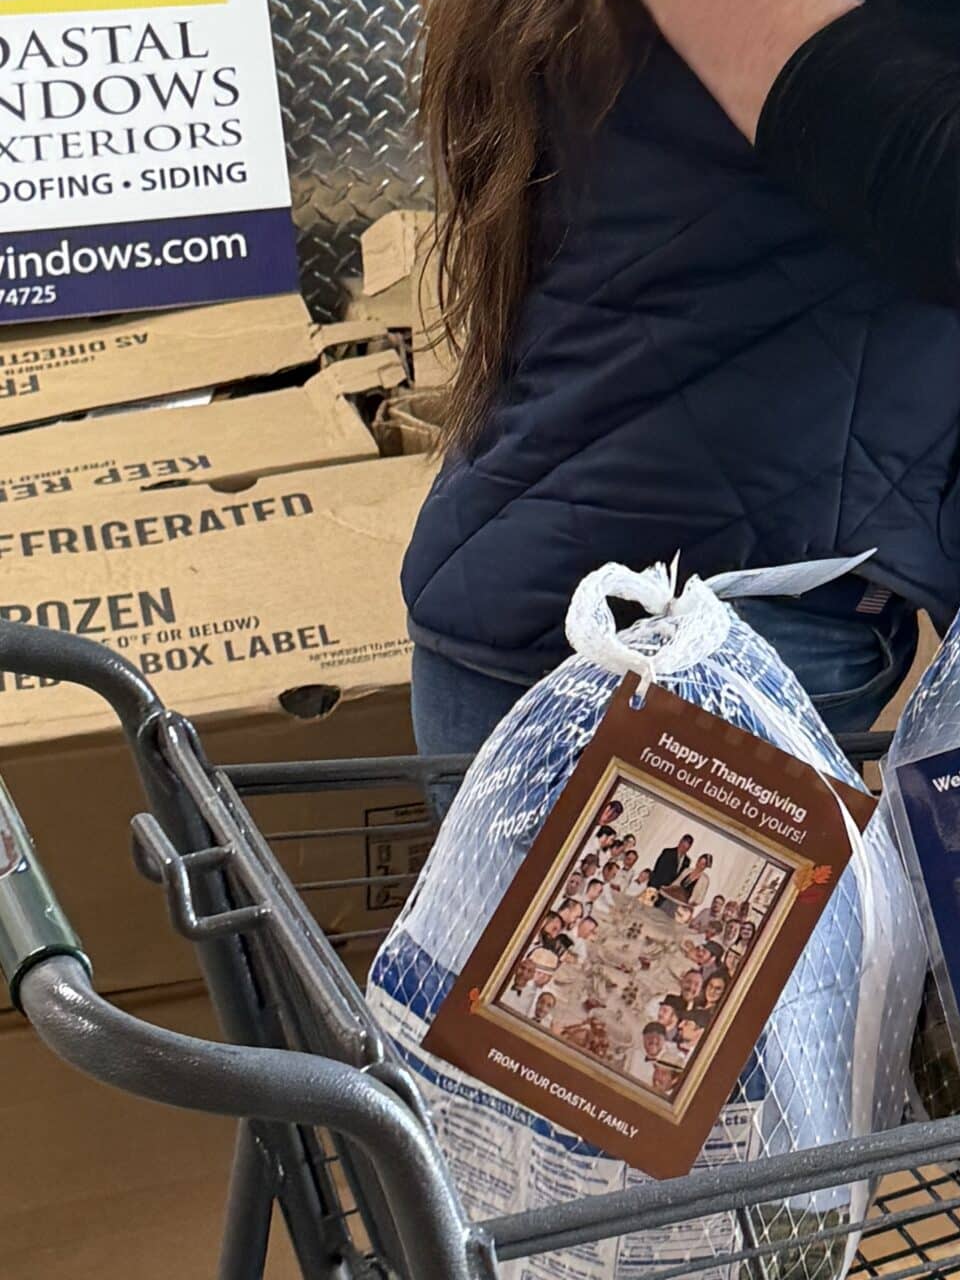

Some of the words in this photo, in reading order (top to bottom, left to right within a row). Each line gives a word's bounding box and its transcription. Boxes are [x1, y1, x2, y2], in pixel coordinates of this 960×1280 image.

[0, 21, 210, 71] ASTAL
[140, 161, 248, 192] SIDING
[0, 232, 248, 282] indows.com
[0, 340, 107, 368] DIRECT
[93, 455, 213, 486] KEEP
[139, 643, 215, 675] BOX
[224, 623, 341, 662] LABEL
[156, 629, 184, 645] OR
[640, 747, 675, 776] from
[676, 769, 703, 789] our
[703, 780, 742, 810] table
[742, 800, 759, 819] to
[760, 811, 808, 846] yours!
[658, 732, 709, 769] Happy
[710, 757, 808, 823] Thanksgiving
[487, 1048, 521, 1074] FROM
[521, 1065, 552, 1089] YOUR
[549, 1082, 602, 1118] COASTAL
[599, 1109, 640, 1139] FAMILY
